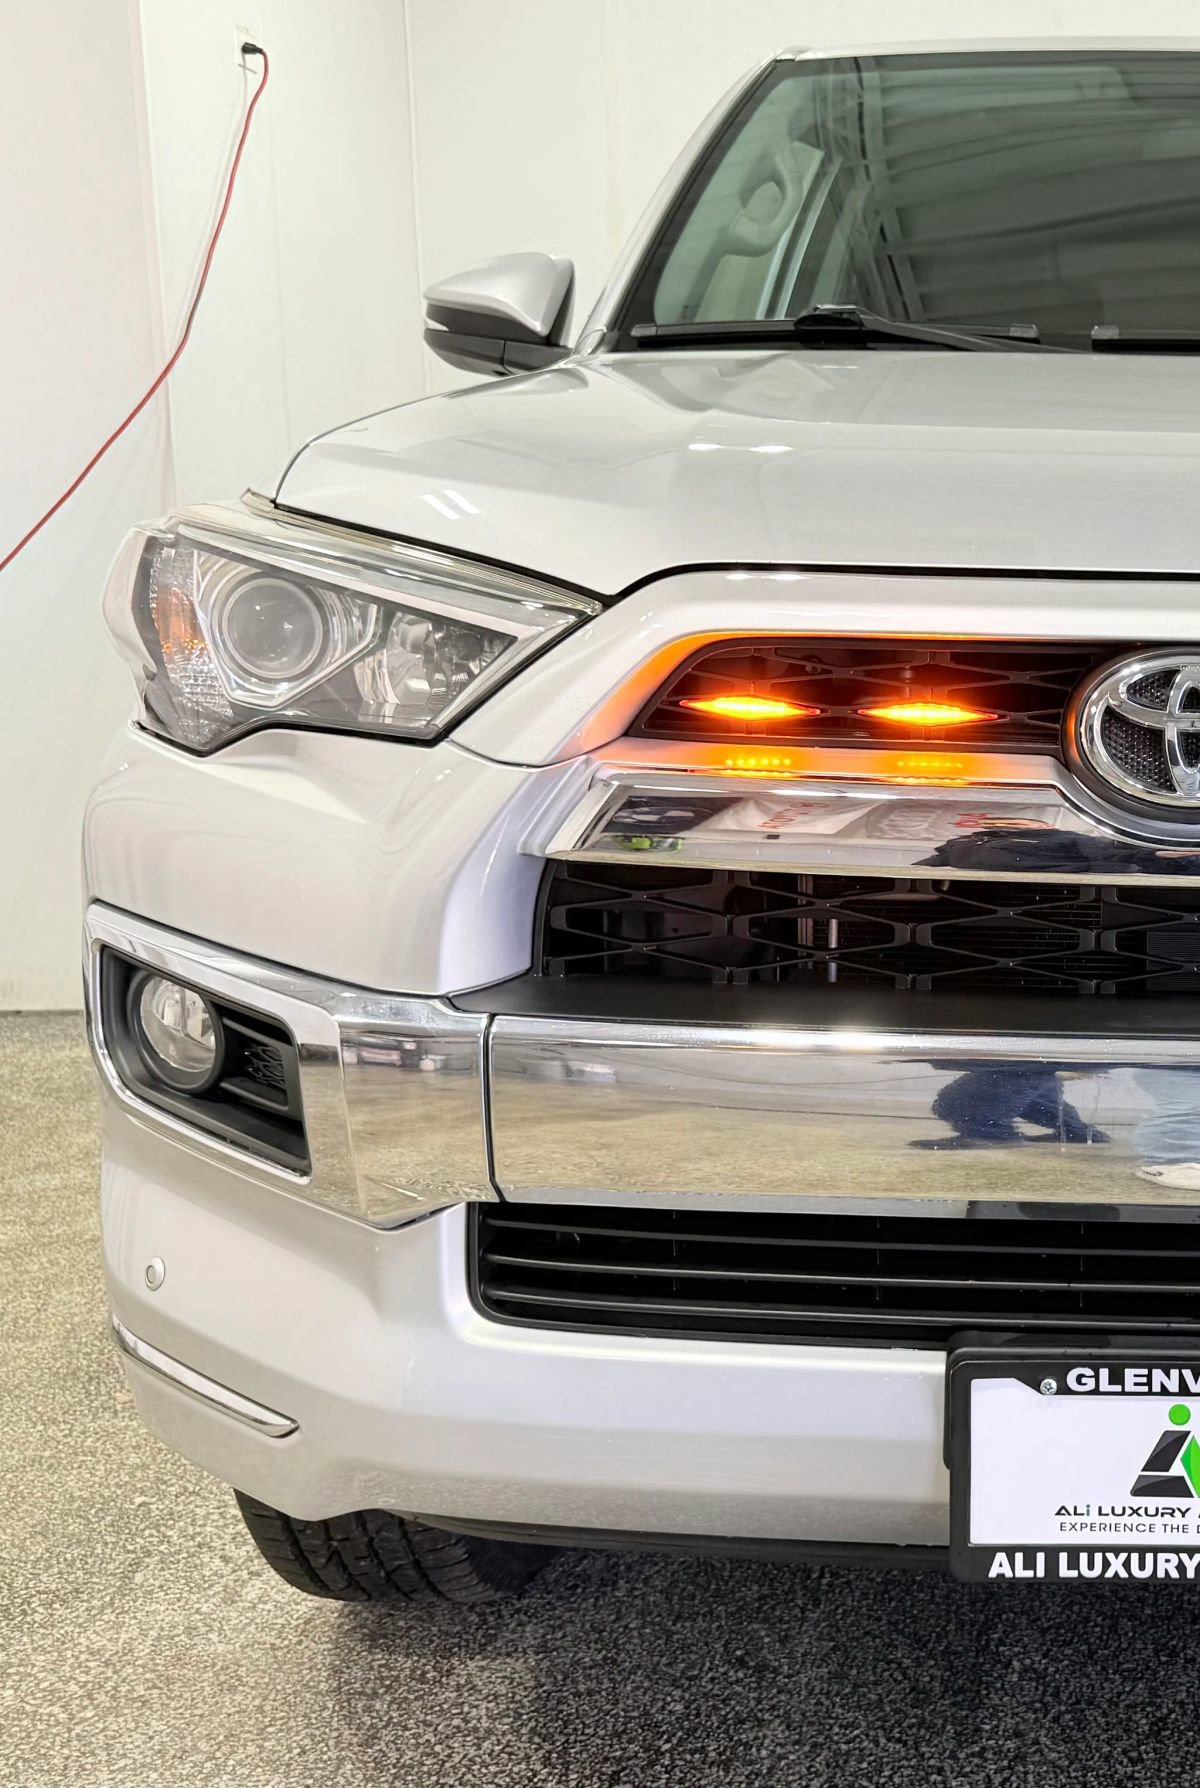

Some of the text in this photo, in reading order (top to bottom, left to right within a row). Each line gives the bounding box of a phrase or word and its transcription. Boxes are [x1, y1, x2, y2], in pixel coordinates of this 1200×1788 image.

[1098, 1505, 1192, 1518] LUXURY
[1059, 1522, 1156, 1533] EXPERIENCE
[1162, 1523, 1189, 1534] THE
[988, 1552, 1045, 1578] ALI
